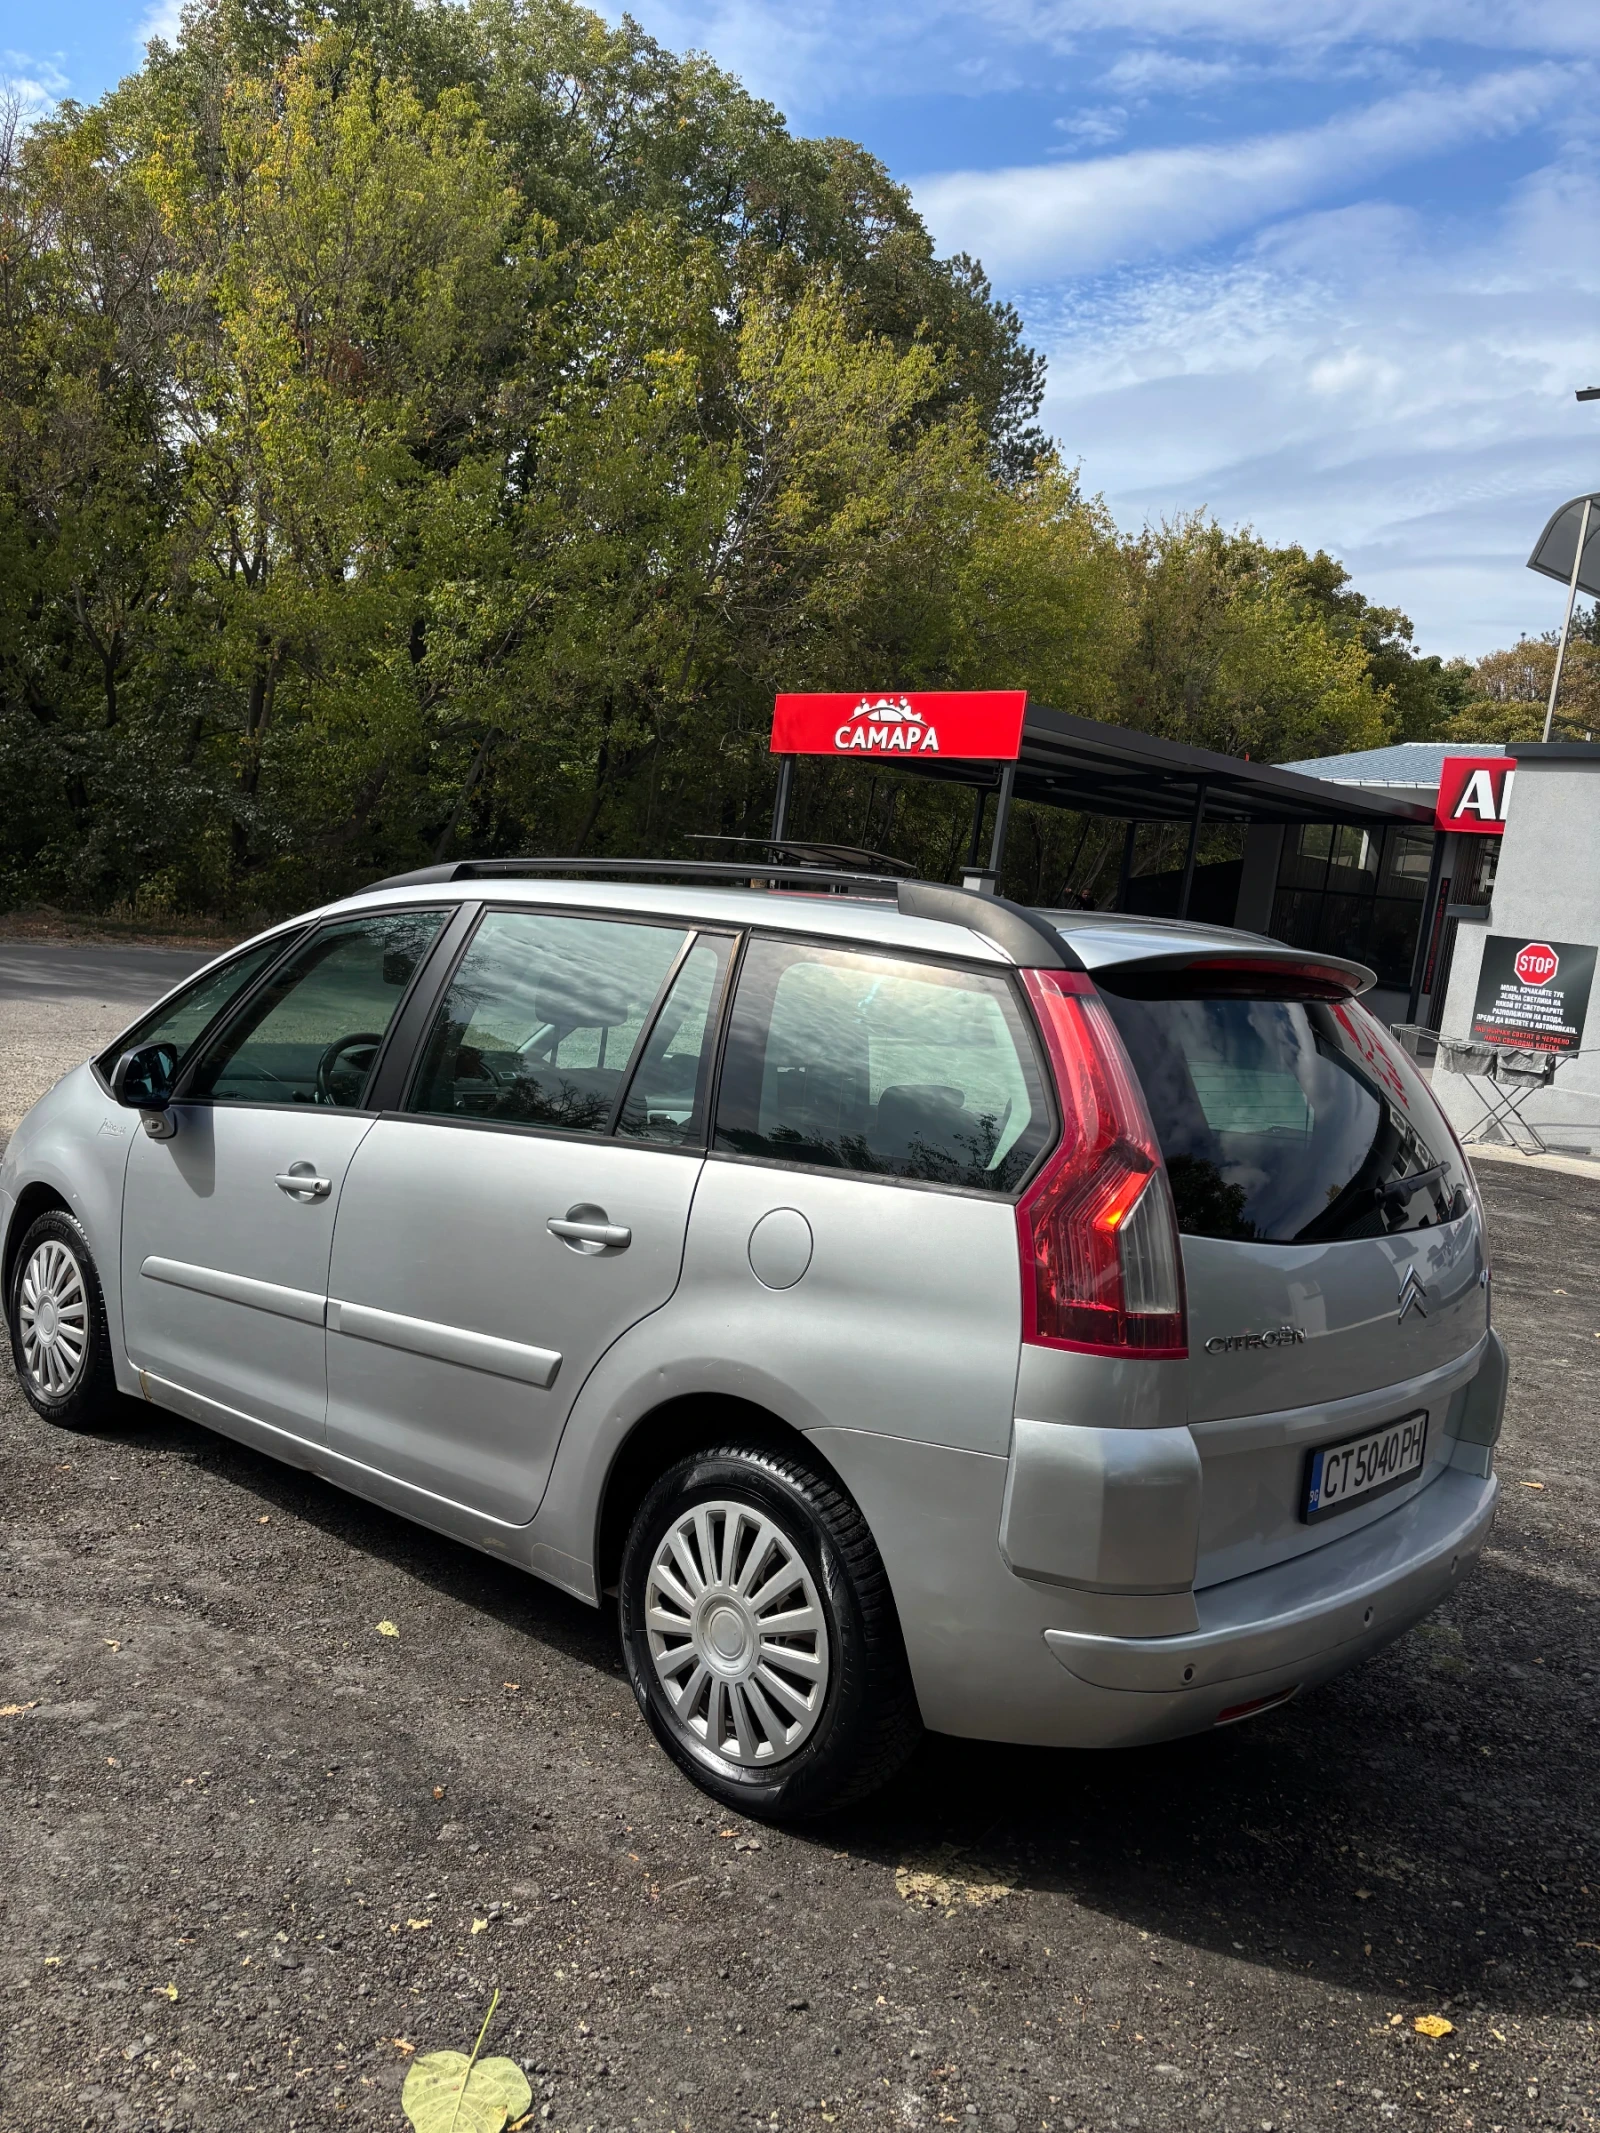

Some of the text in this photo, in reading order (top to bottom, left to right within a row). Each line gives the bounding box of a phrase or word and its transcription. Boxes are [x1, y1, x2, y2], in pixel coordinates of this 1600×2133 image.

[834, 725, 939, 752] САМАРА
[1519, 955, 1554, 973] STOP
[1500, 992, 1522, 1001] ЗЕЛЕНА
[1522, 995, 1552, 1005] СВЕТЛИНА
[1553, 990, 1565, 999] ТУК
[1514, 1002, 1523, 1010] ОТ
[1522, 1003, 1564, 1016] СВЕТОФАРИТЕ
[1476, 1013, 1495, 1023] ПРЕДИ
[1495, 1016, 1504, 1024] ДА
[1504, 1018, 1530, 1028] ВЛЕЗЕТЕ
[1511, 1031, 1535, 1040] СВЕТЯТ
[1541, 1036, 1570, 1045] ЧЕРВЕНО
